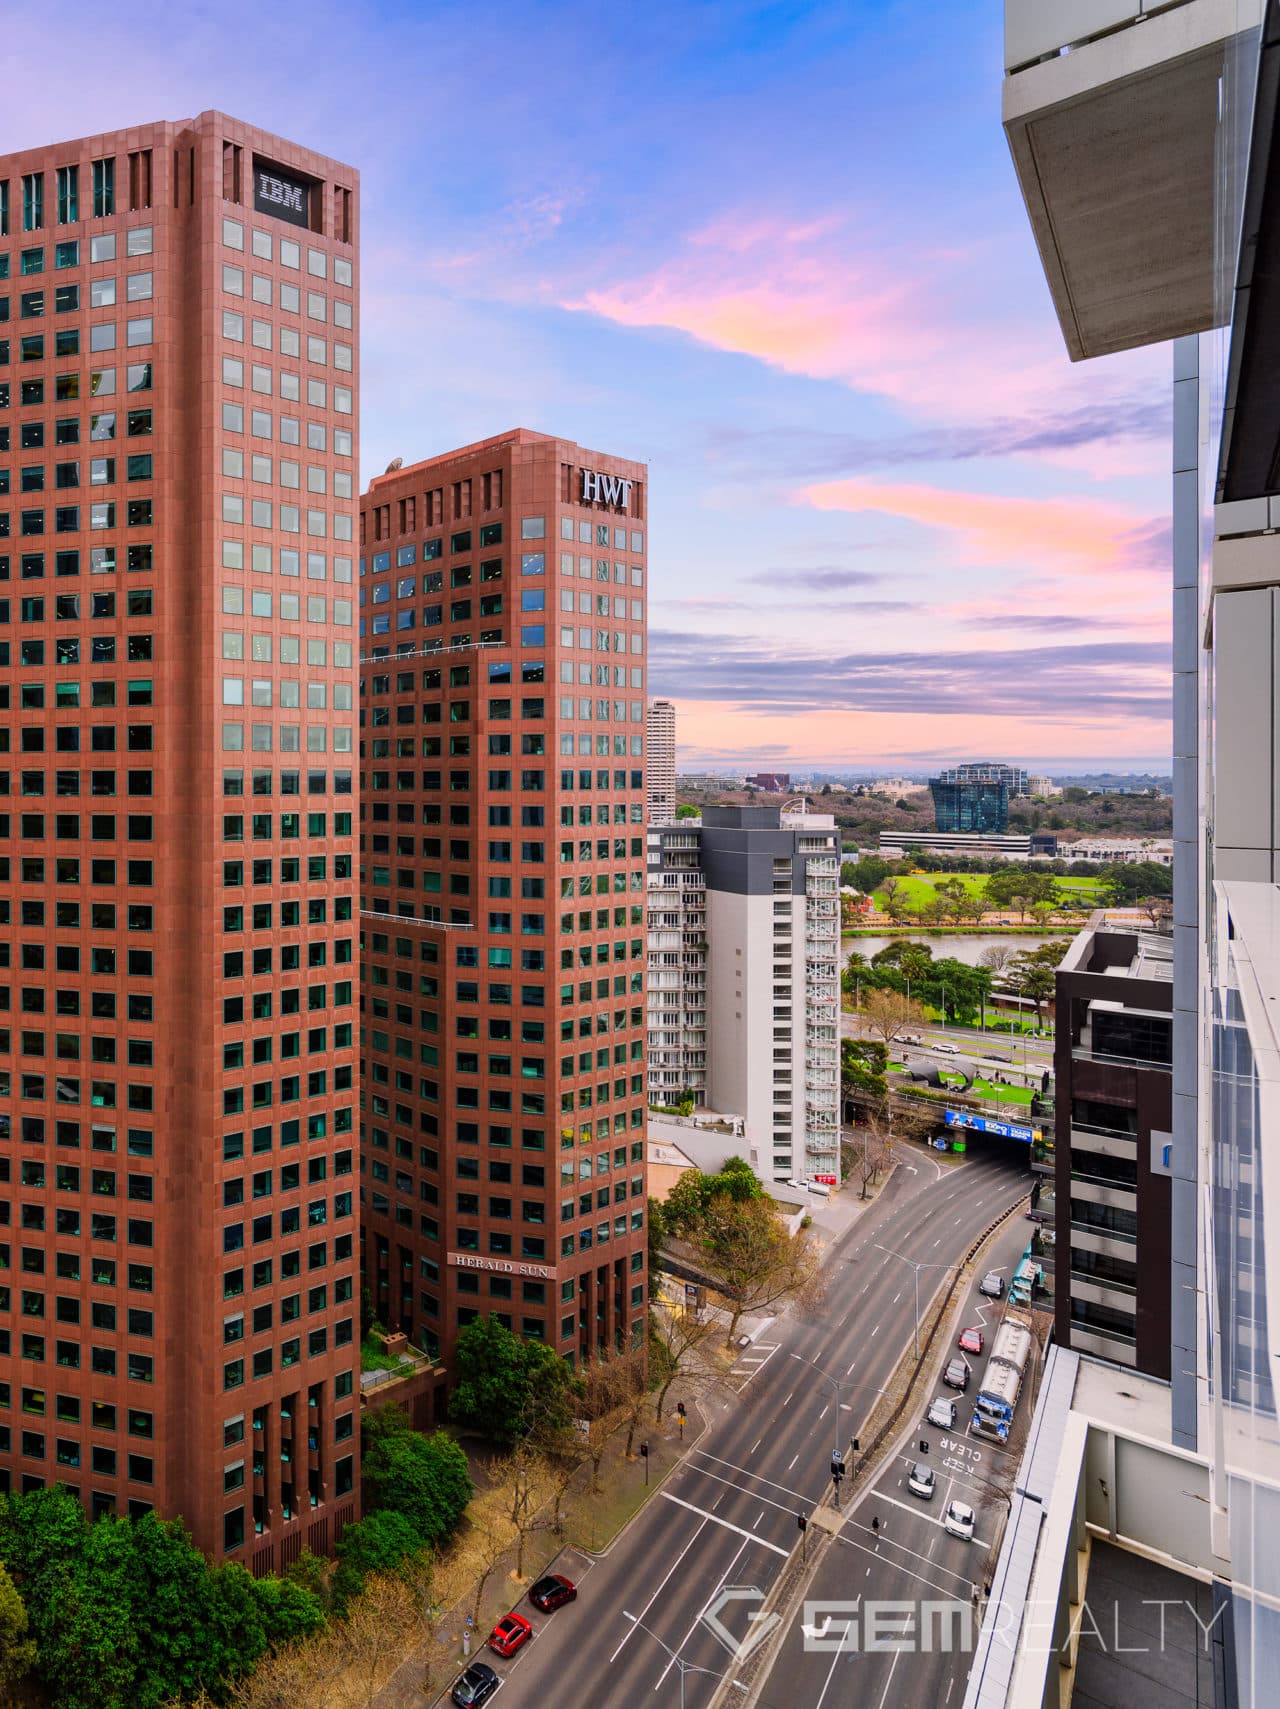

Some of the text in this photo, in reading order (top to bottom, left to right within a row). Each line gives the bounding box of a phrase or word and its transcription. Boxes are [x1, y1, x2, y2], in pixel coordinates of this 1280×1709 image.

[259, 174, 303, 212] IBM
[582, 469, 633, 508] HWT
[456, 1256, 549, 1278] HERALD SUN
[940, 1437, 982, 1462] CLEAR
[942, 1456, 975, 1476] KEEP
